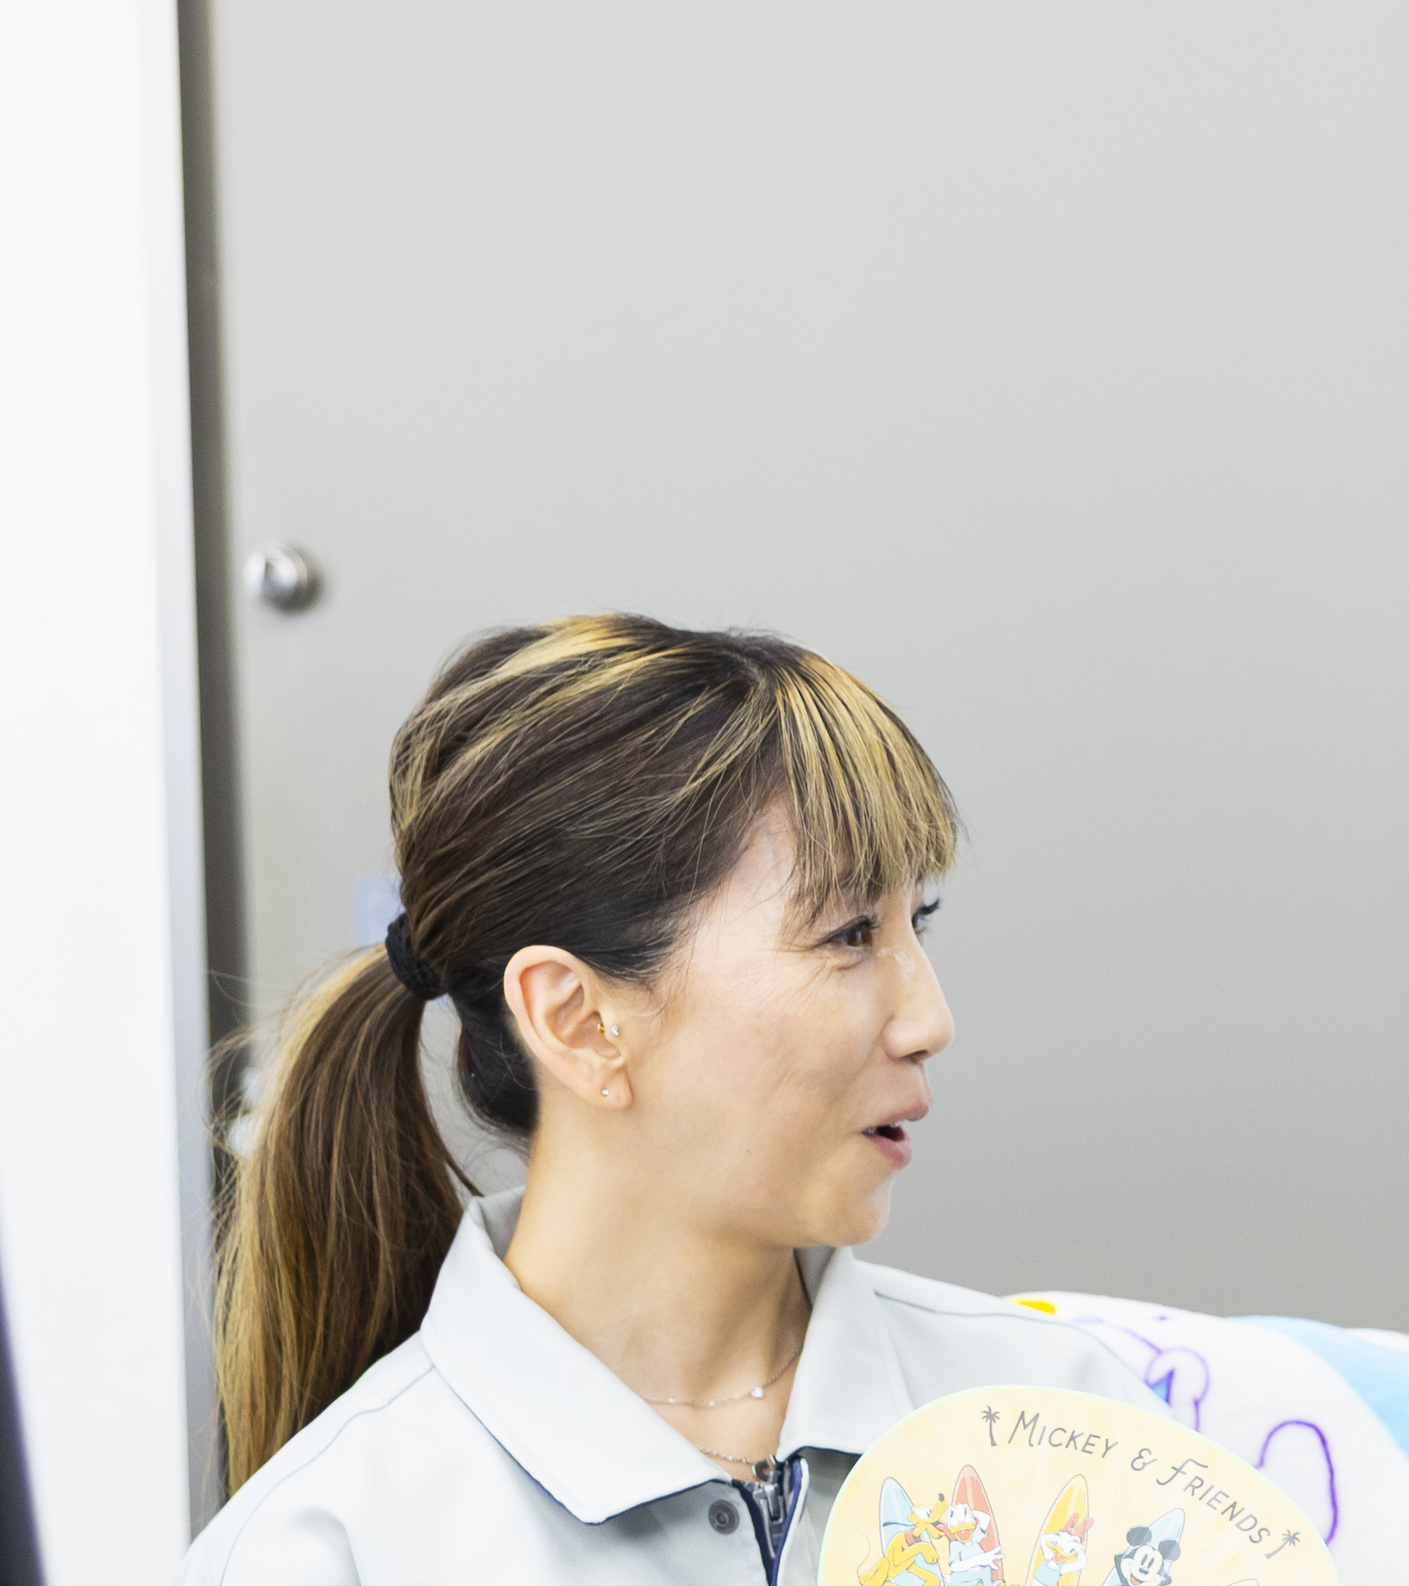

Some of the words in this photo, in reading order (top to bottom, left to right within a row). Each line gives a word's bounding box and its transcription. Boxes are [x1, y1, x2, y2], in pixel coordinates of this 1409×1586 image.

[1008, 1410, 1118, 1459] MICKEY
[1131, 1449, 1157, 1472] &
[1156, 1458, 1271, 1546] FRIENDS
